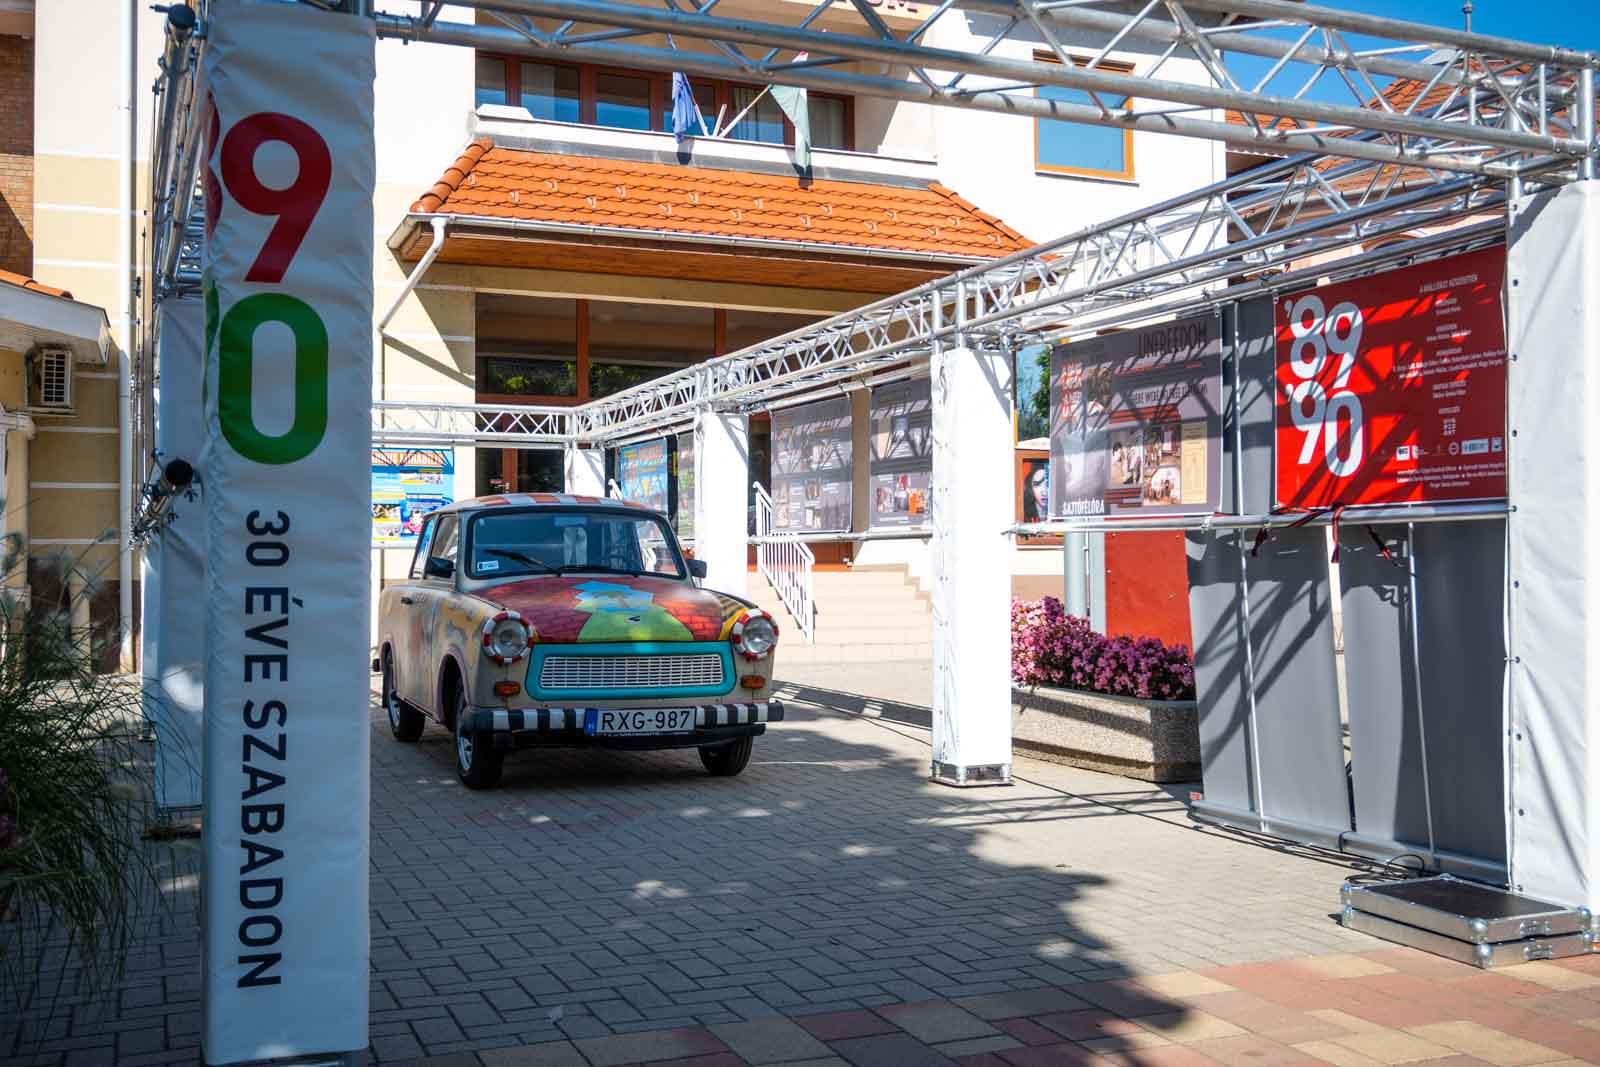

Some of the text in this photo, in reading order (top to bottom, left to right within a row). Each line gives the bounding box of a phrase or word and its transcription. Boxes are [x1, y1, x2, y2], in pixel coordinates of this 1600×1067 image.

[237, 509, 304, 989] 30 ÉVE SZABADON
[601, 710, 691, 731] RXG-987
